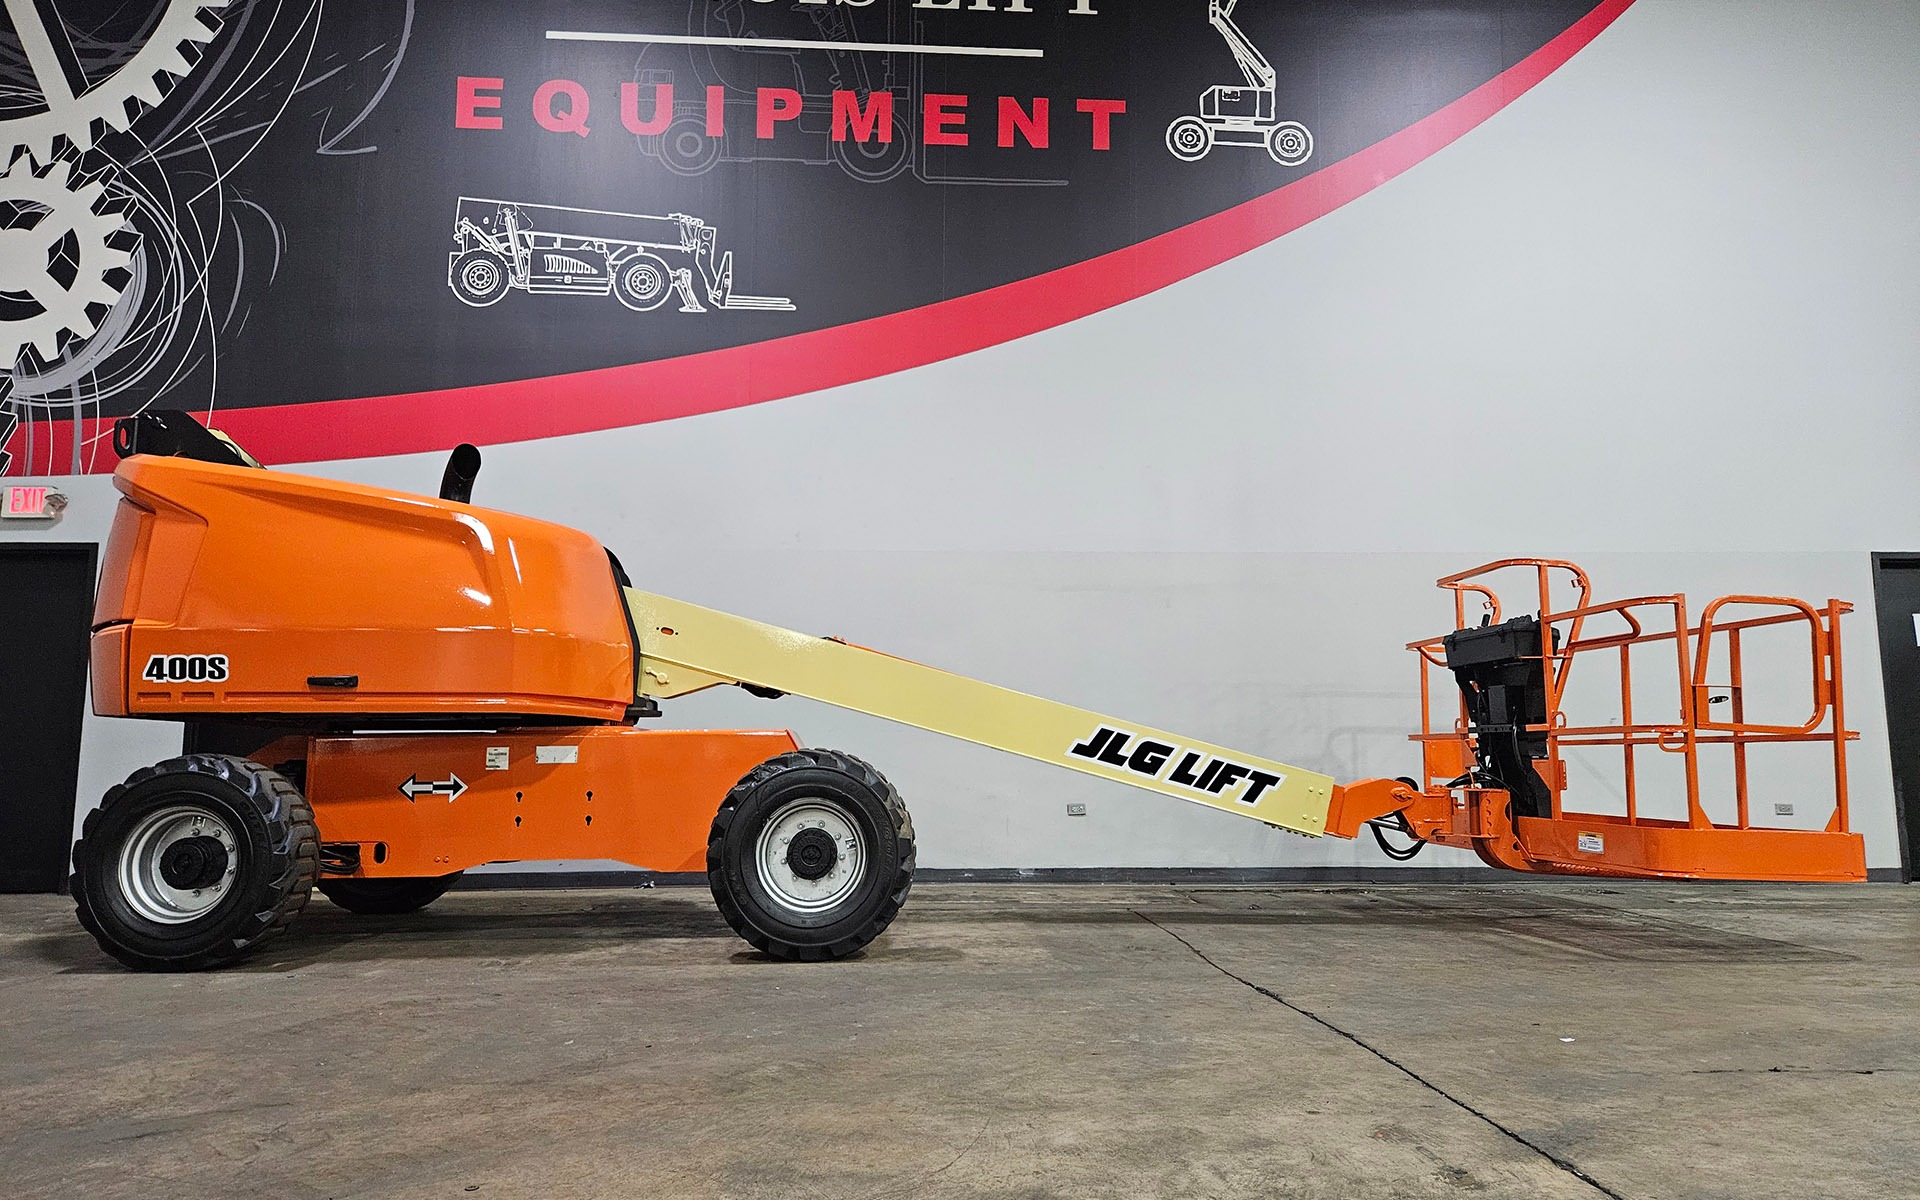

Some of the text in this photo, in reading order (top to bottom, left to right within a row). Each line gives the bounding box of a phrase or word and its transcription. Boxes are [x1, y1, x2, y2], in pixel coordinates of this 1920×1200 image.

[455, 76, 1126, 150] EQUIPMENT
[10, 487, 47, 513] EXIT
[145, 656, 226, 681] 400S
[1071, 727, 1281, 804] JLG LIFT
